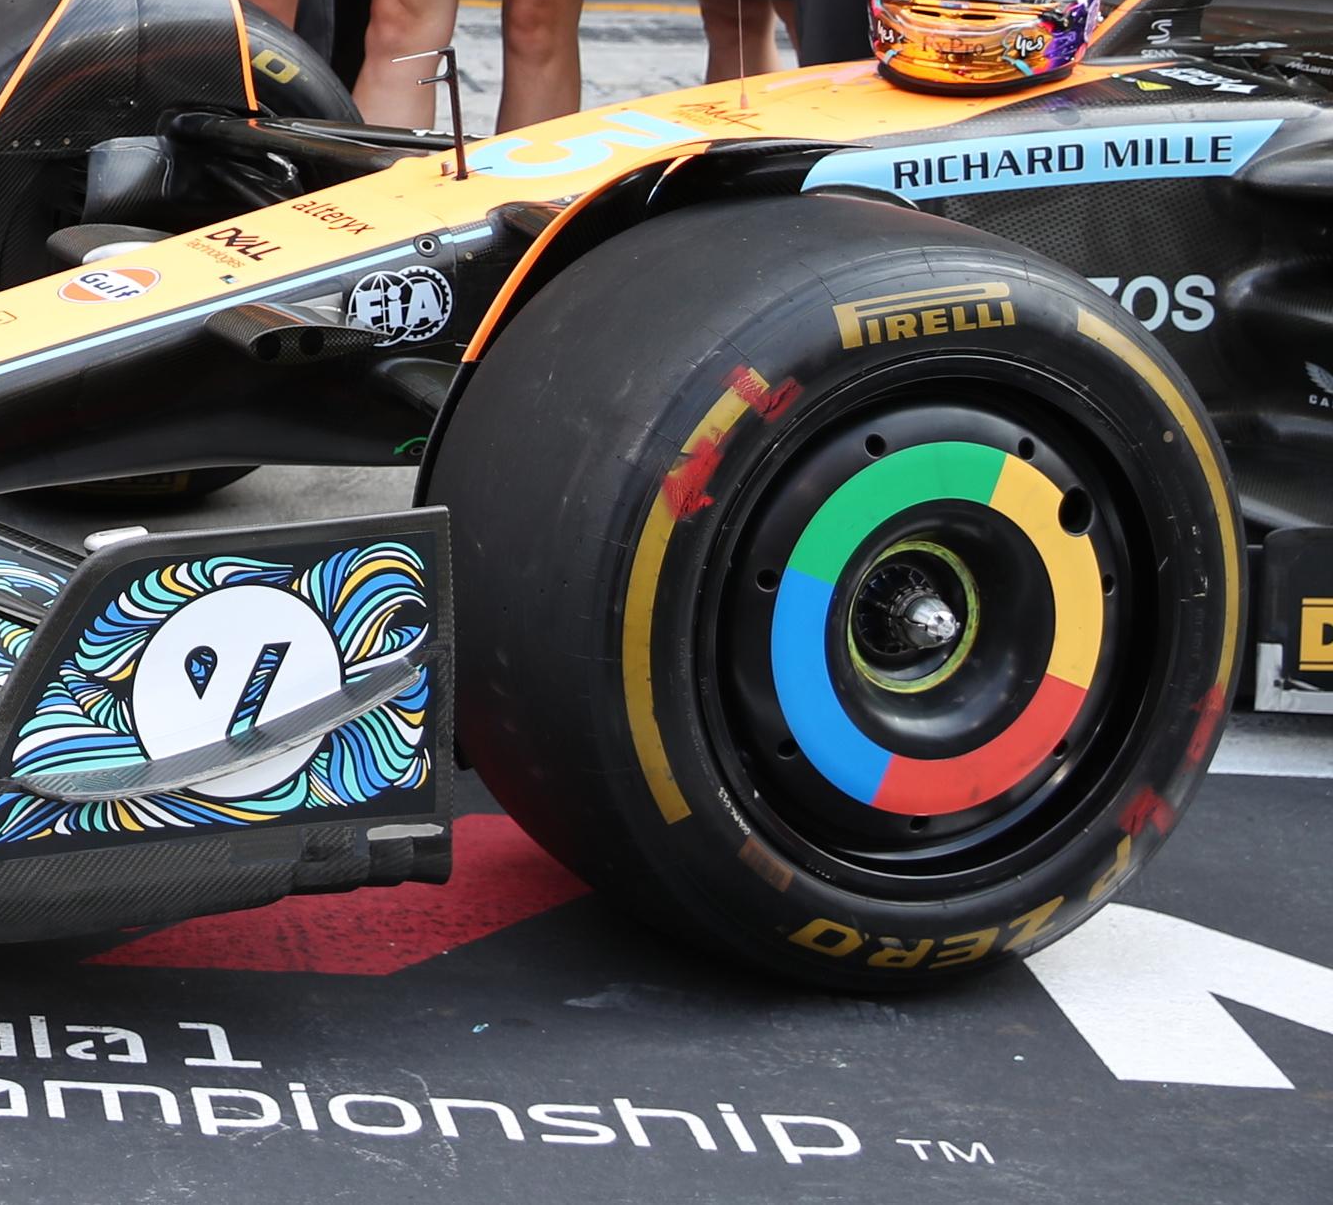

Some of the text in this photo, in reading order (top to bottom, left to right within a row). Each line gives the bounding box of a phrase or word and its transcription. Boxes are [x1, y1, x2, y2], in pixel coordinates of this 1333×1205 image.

[892, 135, 1234, 190] RICHARD MILLE
[291, 199, 375, 236] alteryx
[205, 227, 282, 262] DELL
[79, 267, 140, 302] Gulf
[833, 281, 1017, 350] PIRELLI
[788, 897, 1065, 970] ZERO
[178, 1020, 263, 1069] 1
